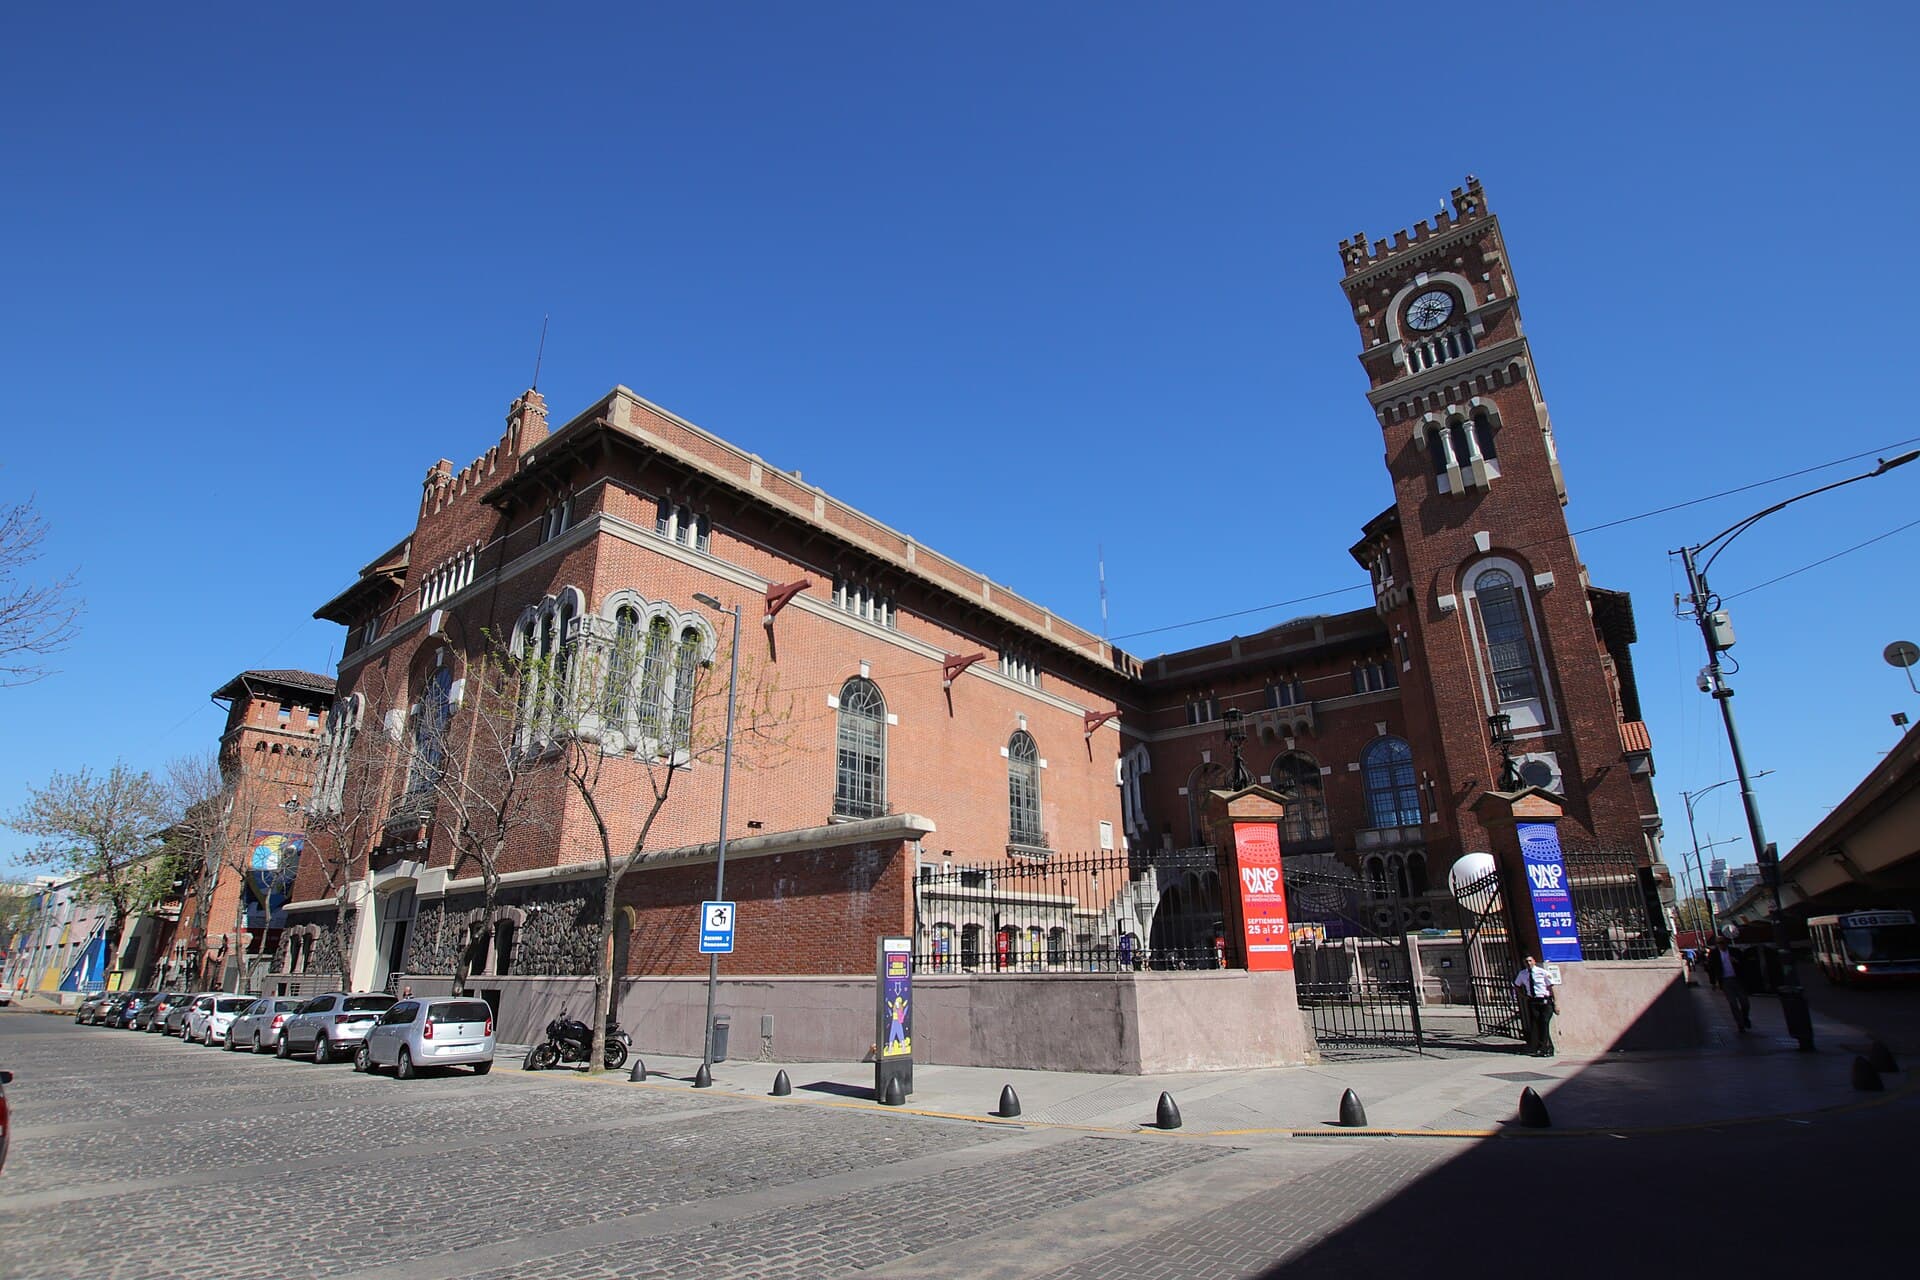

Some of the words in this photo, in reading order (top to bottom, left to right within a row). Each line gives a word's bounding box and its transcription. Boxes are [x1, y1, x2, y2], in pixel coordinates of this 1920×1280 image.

[1242, 867, 1279, 881] INNO
[1527, 864, 1562, 878] INNO
[1245, 880, 1275, 893] VAR
[1532, 877, 1560, 889] VAR
[1539, 919, 1551, 928] 25
[1552, 919, 1560, 928] al
[1561, 918, 1572, 927] 27
[1851, 917, 1878, 925] 168
[1248, 925, 1261, 935] 25
[1262, 925, 1270, 935] al
[1272, 925, 1285, 934] 27
